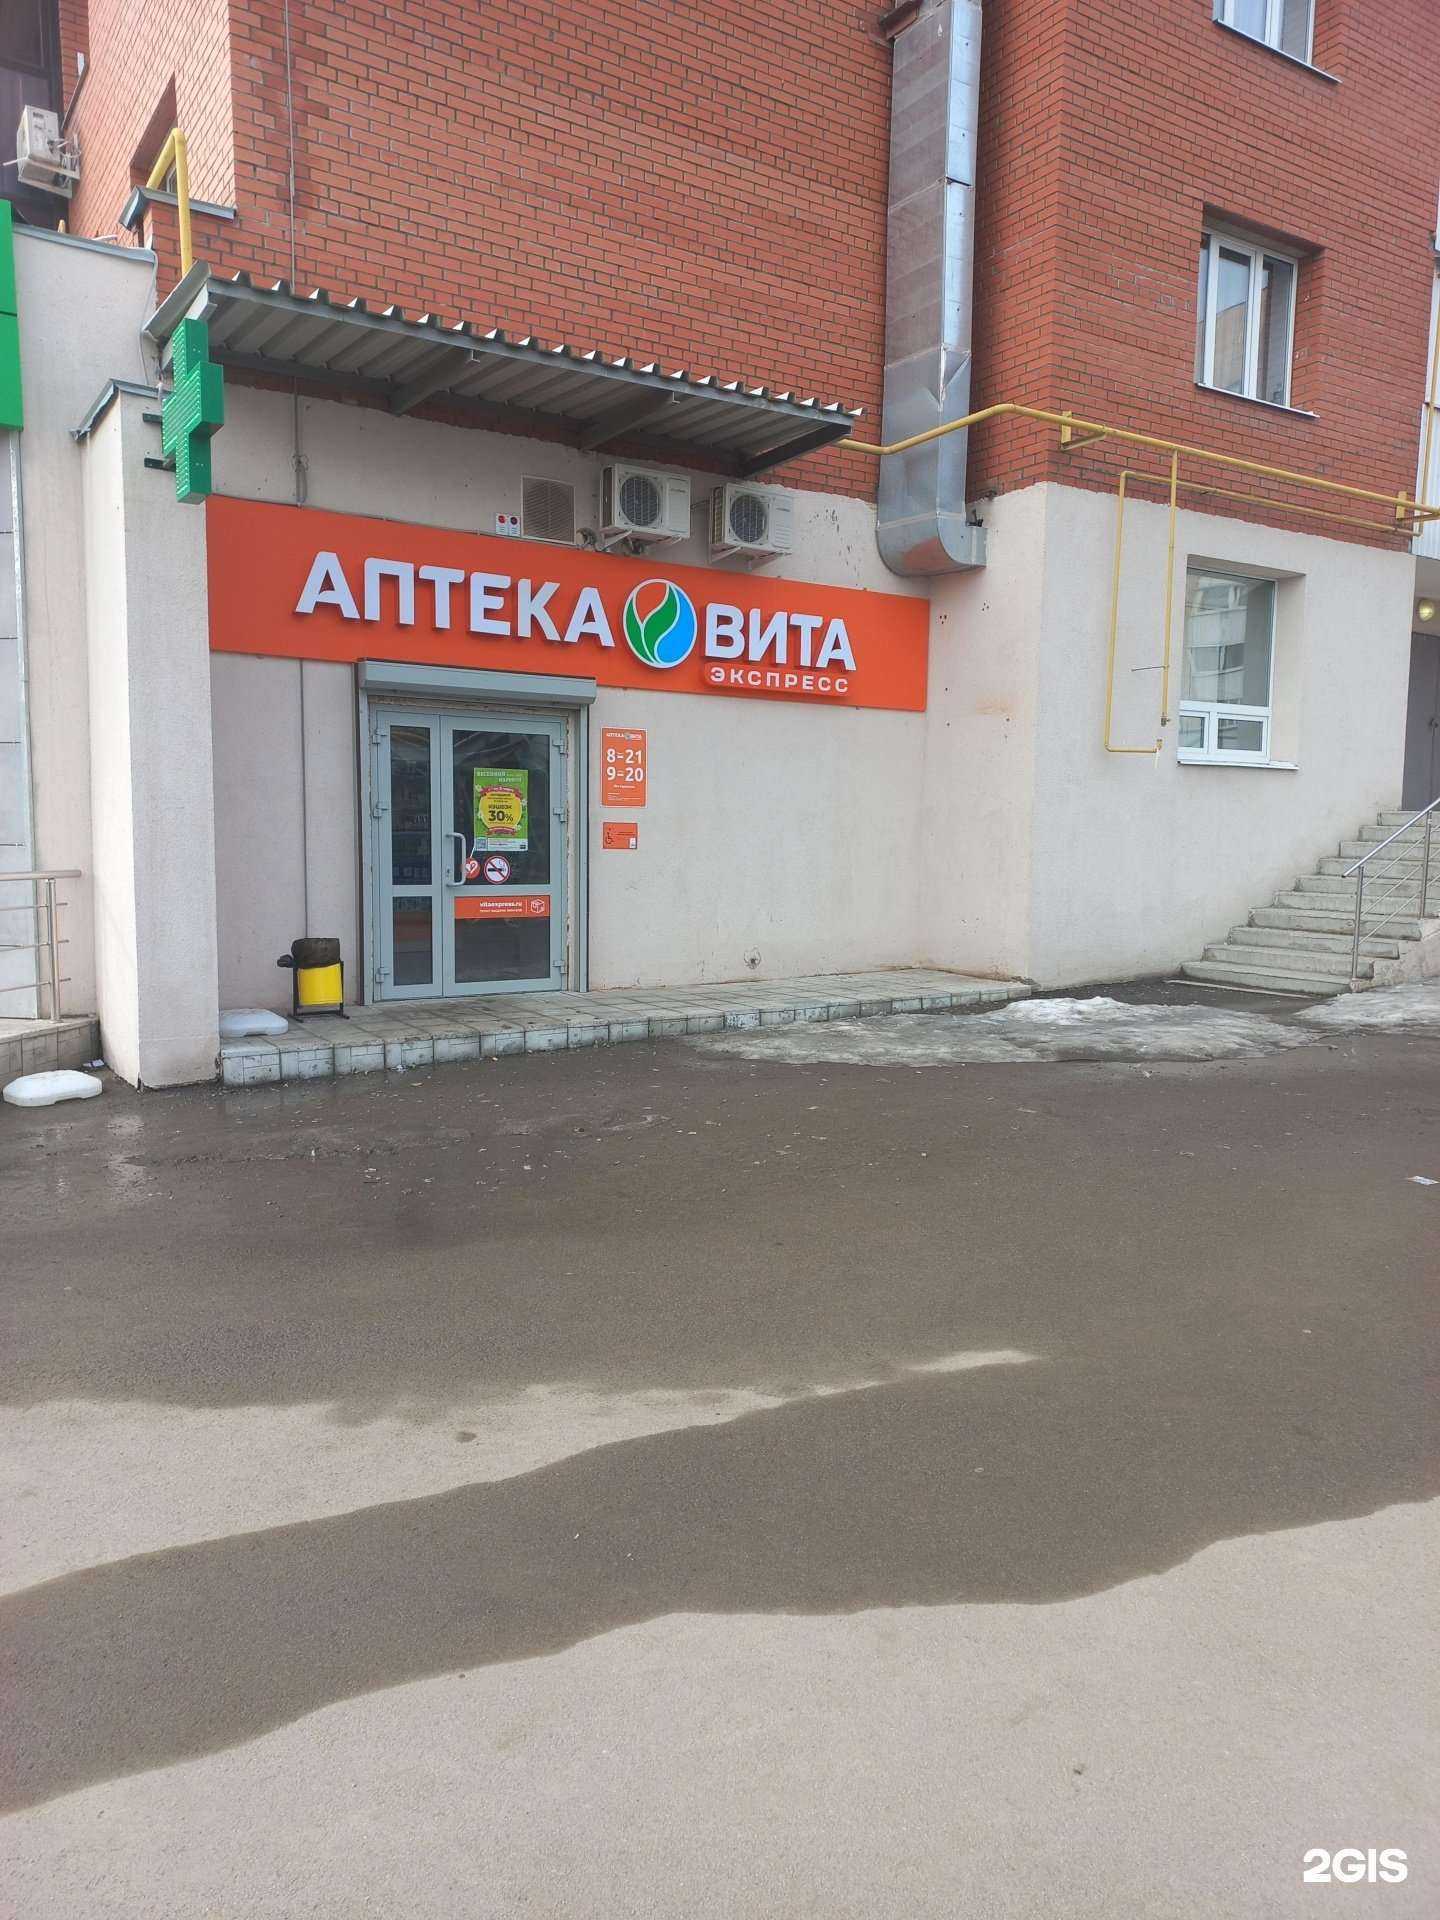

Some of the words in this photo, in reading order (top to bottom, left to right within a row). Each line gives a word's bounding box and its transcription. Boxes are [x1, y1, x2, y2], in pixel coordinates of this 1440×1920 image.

[295, 550, 616, 648] АПТЕКА
[705, 602, 857, 671] ВИТА
[710, 666, 849, 693] ЭКСПРЕСС
[488, 810, 514, 822] 30%
